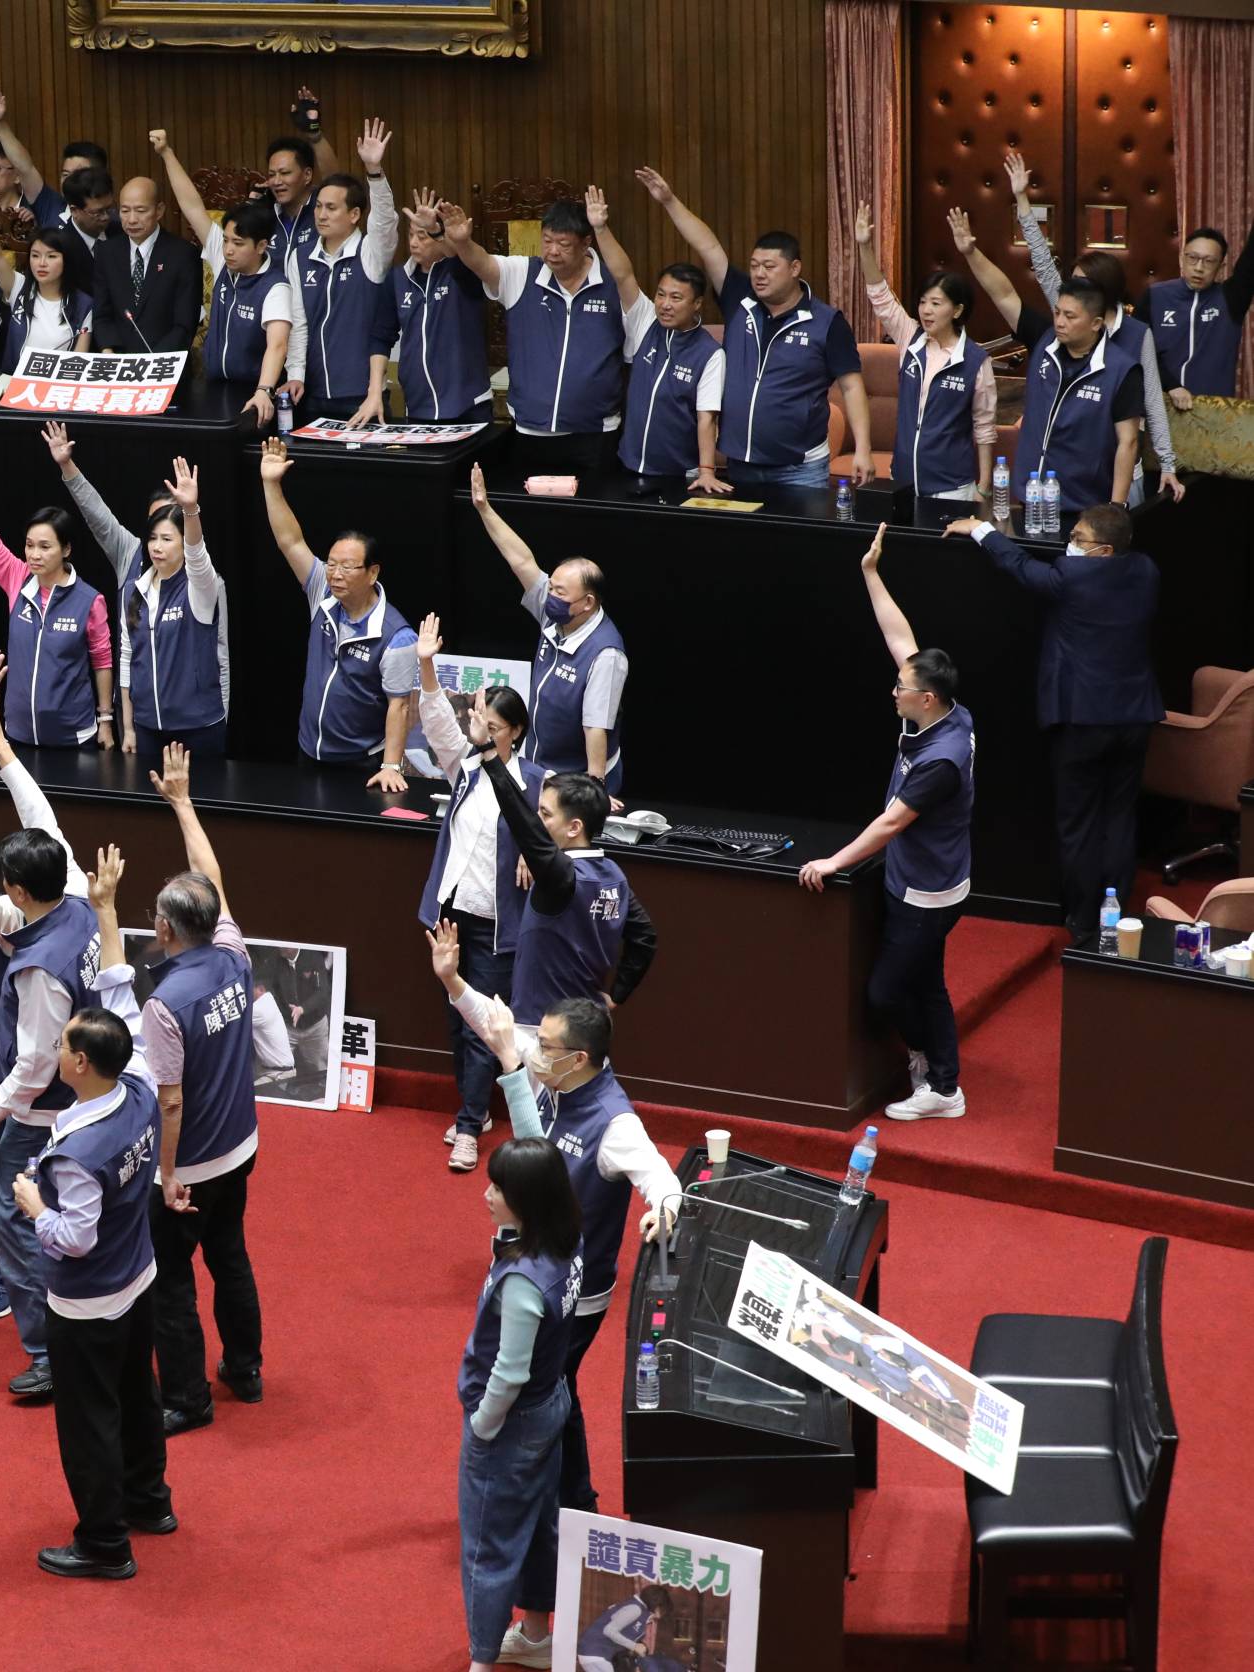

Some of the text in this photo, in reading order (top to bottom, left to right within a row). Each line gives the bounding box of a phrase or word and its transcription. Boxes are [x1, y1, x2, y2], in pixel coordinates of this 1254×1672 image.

[583, 303, 607, 313] 陳雪生
[23, 351, 181, 382] 國會要改革
[8, 382, 171, 412] 人民要真相
[940, 379, 966, 392] 王育敏
[52, 622, 79, 632] 柯志恩
[413, 663, 510, 692] 責暴力
[118, 1128, 156, 1189] 鄭天
[555, 1137, 584, 1159] 羅智強
[967, 1390, 1010, 1470] 譴責暴力
[587, 1528, 732, 1595] 譴責暴力
